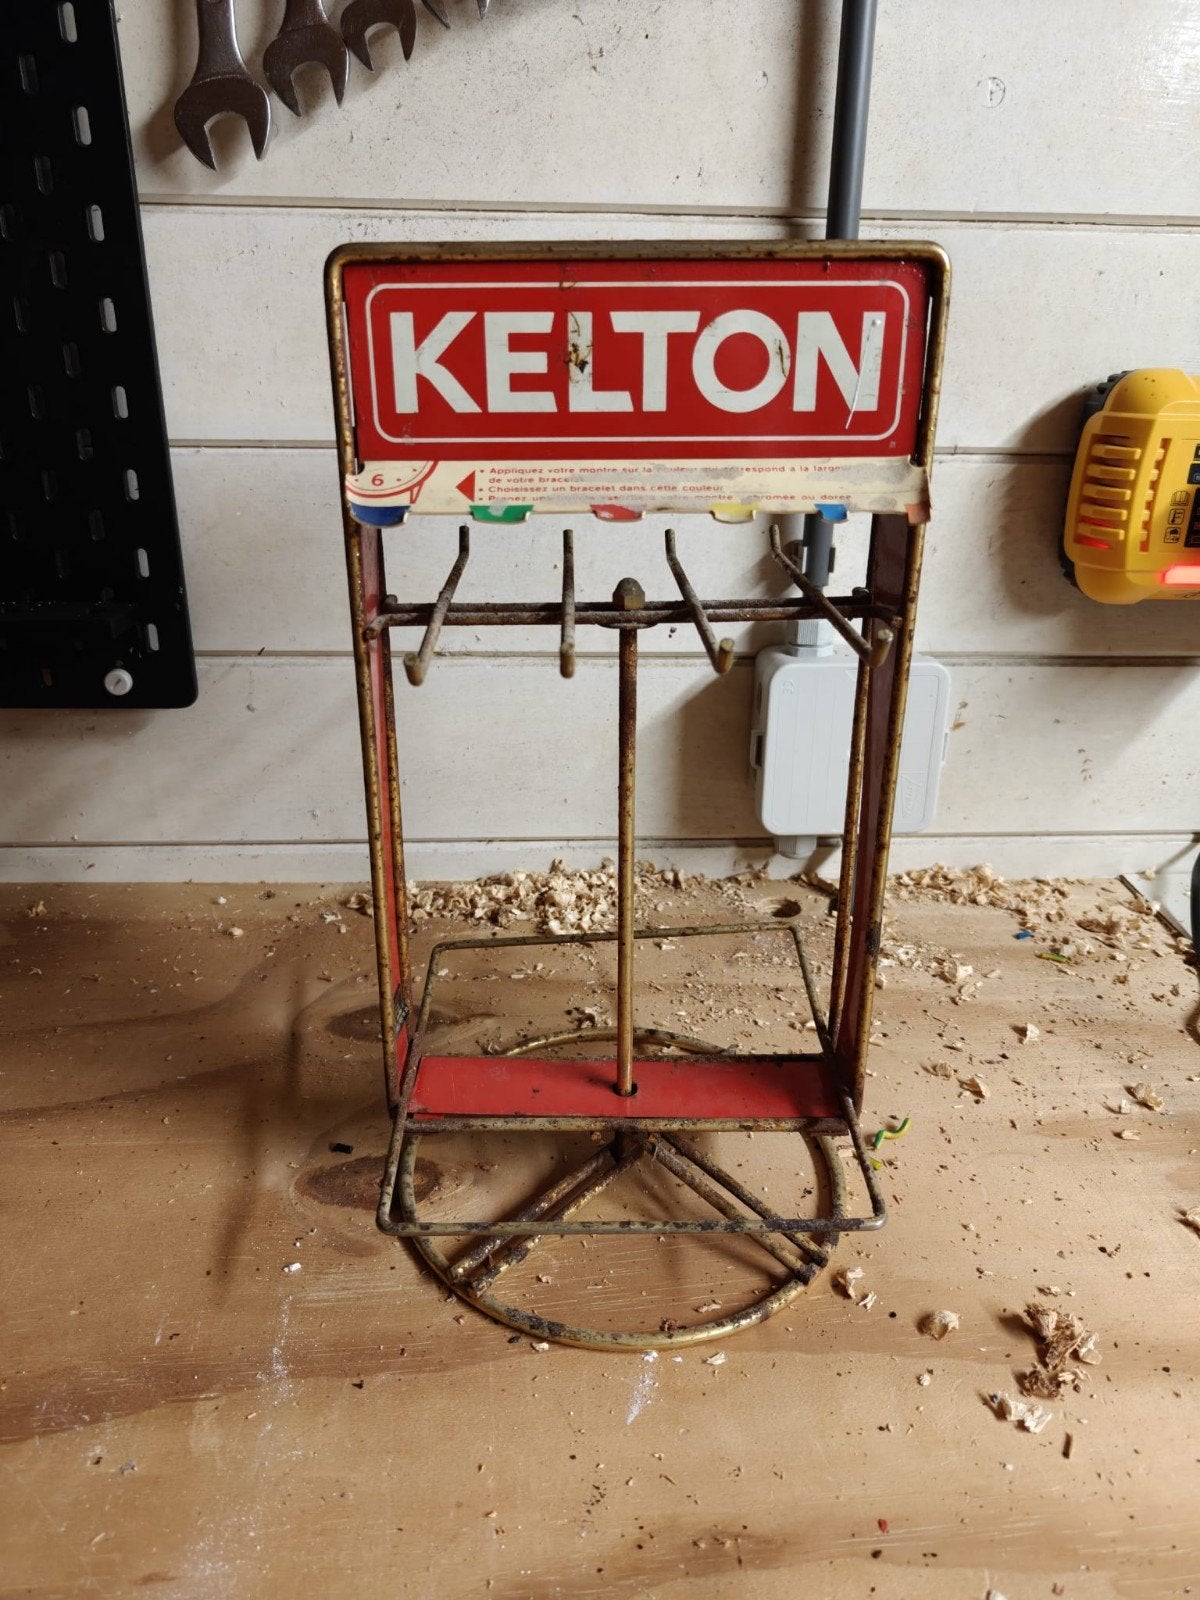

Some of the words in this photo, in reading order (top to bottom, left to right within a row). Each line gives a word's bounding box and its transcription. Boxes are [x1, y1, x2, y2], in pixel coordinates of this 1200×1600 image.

[389, 309, 887, 414] KELTON
[489, 467, 544, 475] Appliquez
[371, 473, 384, 487] 6
